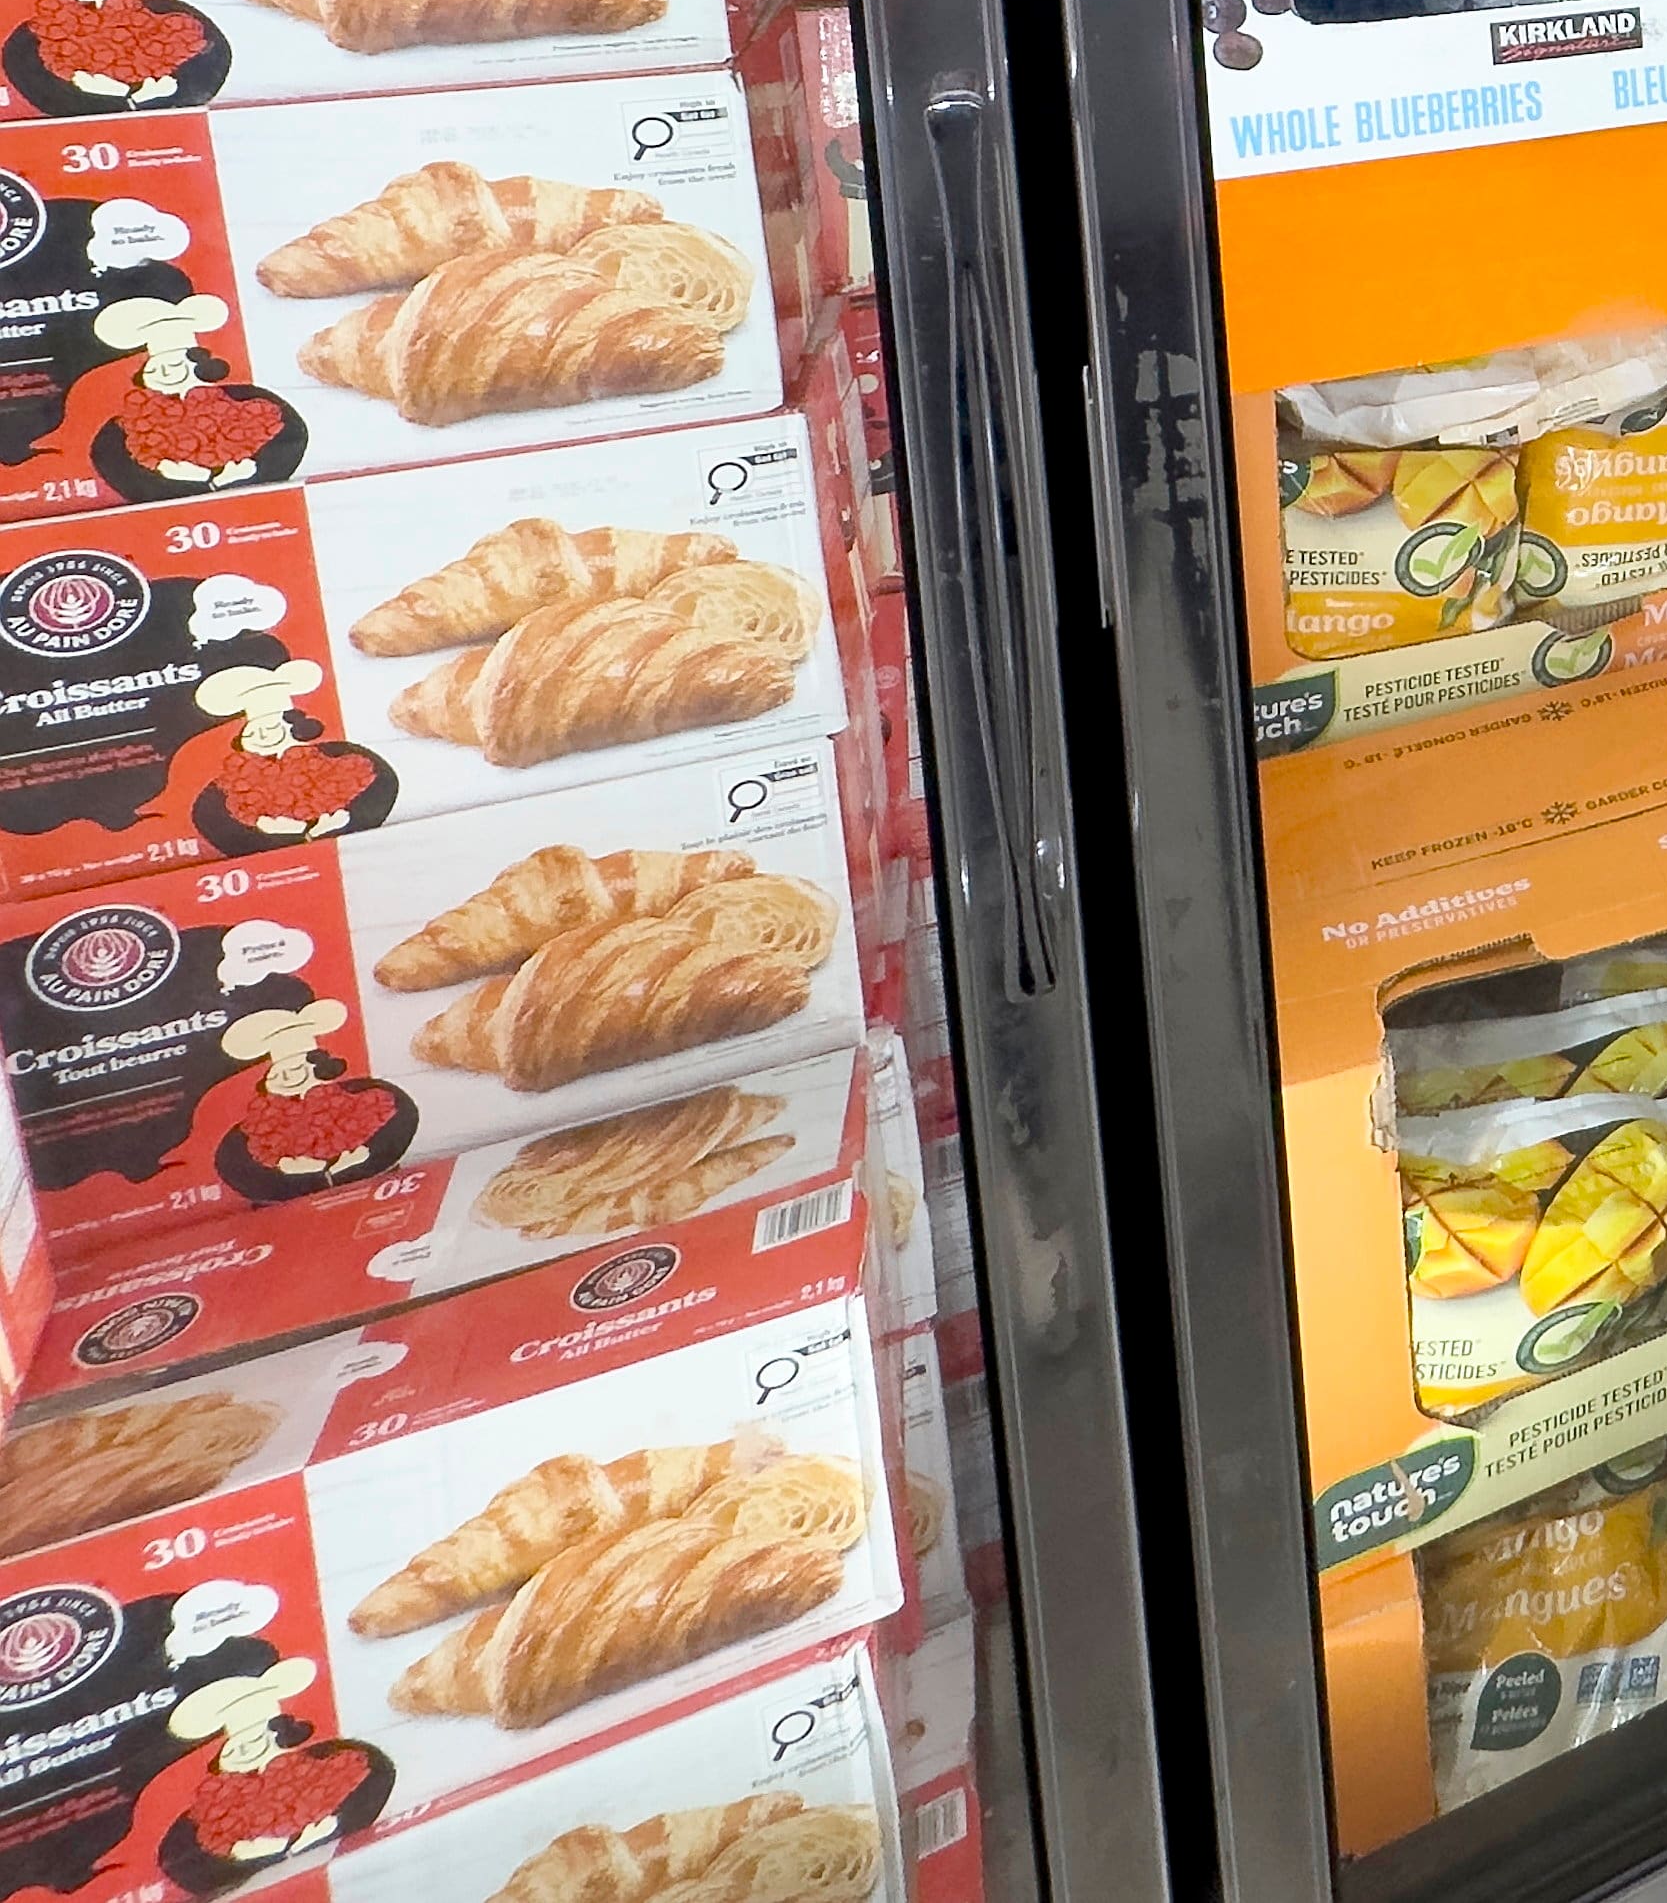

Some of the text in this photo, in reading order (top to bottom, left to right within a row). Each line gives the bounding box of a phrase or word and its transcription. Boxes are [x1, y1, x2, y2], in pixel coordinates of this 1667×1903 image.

[1498, 13, 1636, 44] KIRKLAND
[1231, 106, 1339, 158] WHOLE
[1356, 81, 1542, 145] BLUEBERRIES
[62, 143, 119, 173] 30
[166, 521, 220, 553] 30
[1290, 570, 1380, 585] PESTICIDES
[1299, 550, 1358, 565] TESTED
[6, 596, 138, 648] AU PAIN DORÉ
[1344, 673, 1521, 722] TESTÉ POUR PESTICIDES
[1365, 659, 1501, 698] PESTICIDE TESTED
[35, 697, 150, 727] All Butter
[1370, 849, 1418, 871] KEEP
[1421, 829, 1488, 858] FROZEN
[1585, 785, 1647, 812] GARDER
[148, 843, 174, 863] 2,1
[197, 869, 249, 903] 30
[1322, 876, 1532, 942] No Additives
[41, 972, 65, 994] AU
[65, 986, 120, 1003] PAIN
[6, 1009, 228, 1075] Croissants
[53, 1044, 188, 1084] Tout beurre
[170, 1189, 197, 1209] 2,1
[508, 1283, 716, 1364] Croissants
[1509, 1369, 1664, 1447] PESTICIDE TESTED
[1485, 1441, 1539, 1478] TESTÉ
[1543, 1424, 1588, 1457] POUR
[1328, 1453, 1461, 1521] nature's
[1330, 1486, 1438, 1545] touch
[142, 1527, 208, 1571] 30
[1496, 1671, 1543, 1688] Peeled
